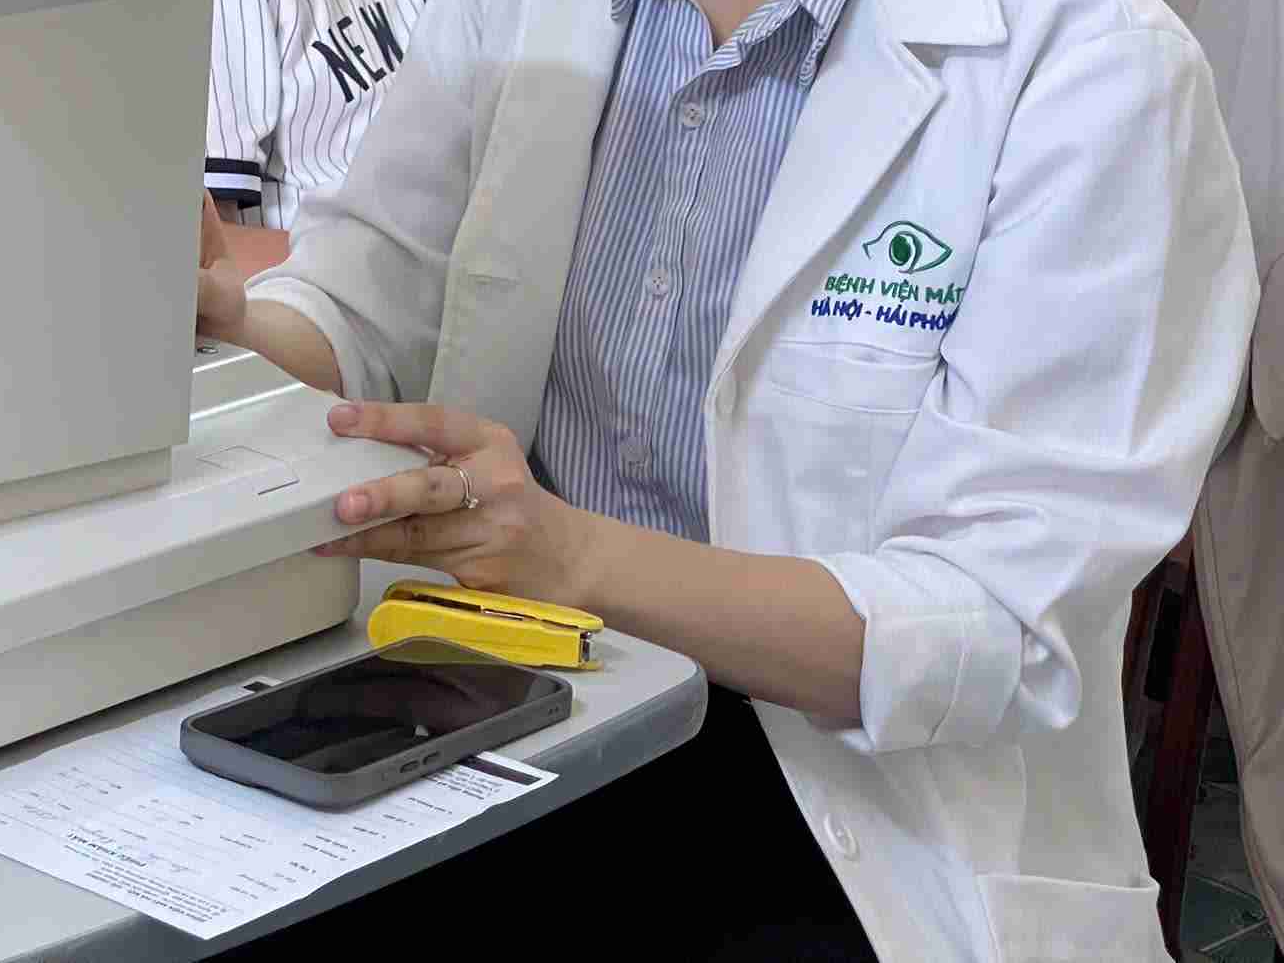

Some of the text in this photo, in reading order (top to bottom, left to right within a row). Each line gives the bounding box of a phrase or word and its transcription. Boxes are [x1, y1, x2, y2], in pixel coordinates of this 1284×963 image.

[311, 1, 404, 104] NEW
[825, 274, 875, 295] BỆNH
[881, 279, 920, 302] VIỆN
